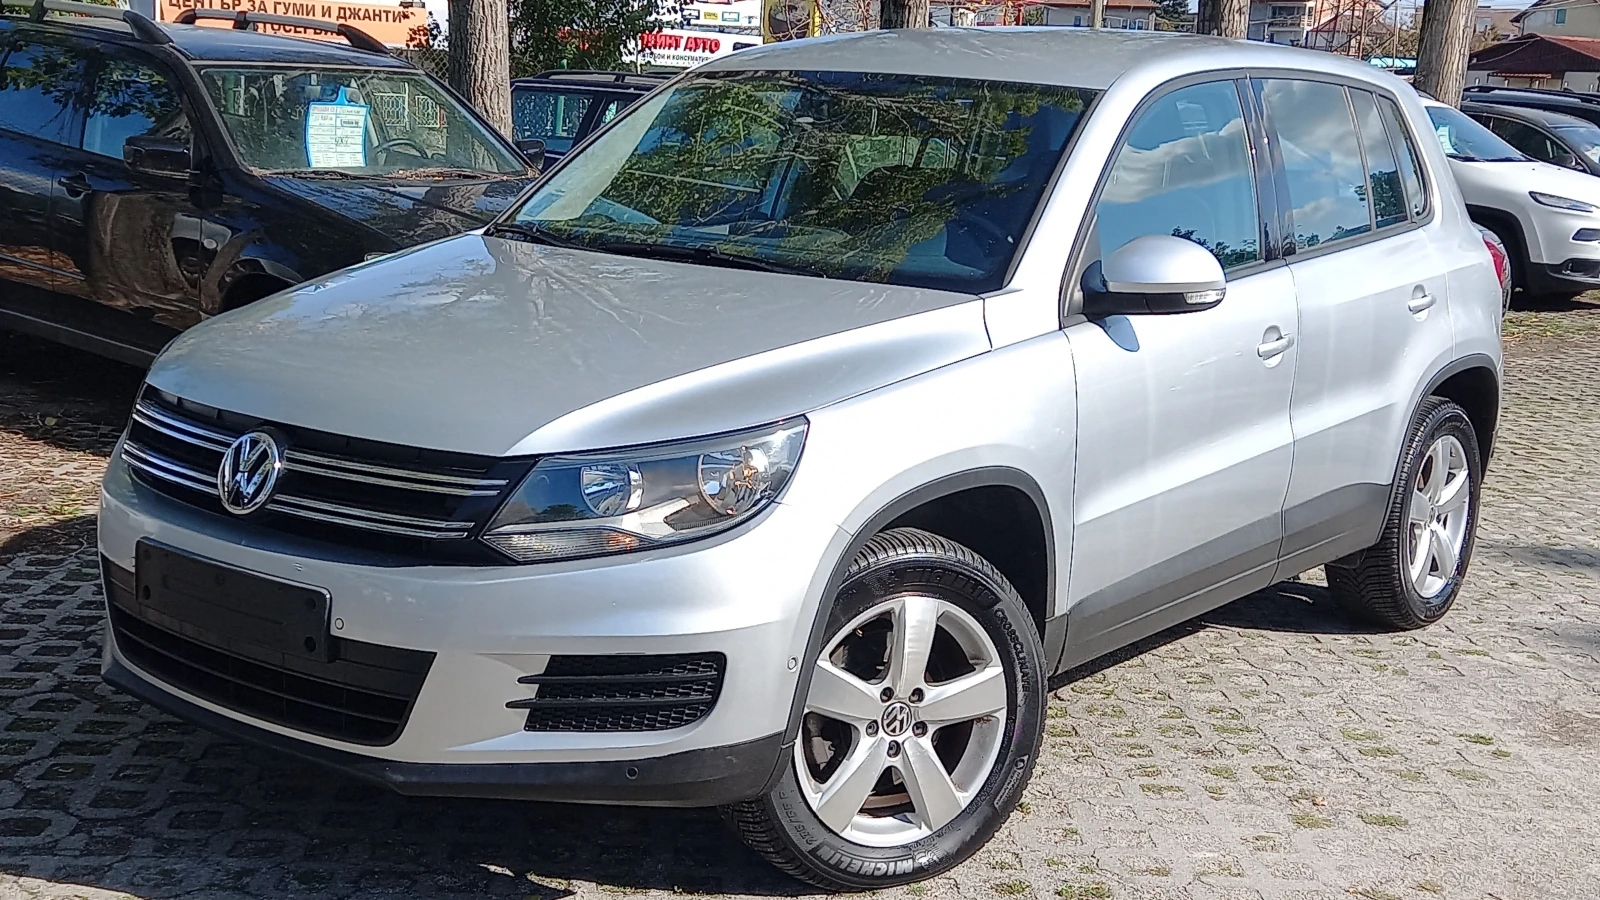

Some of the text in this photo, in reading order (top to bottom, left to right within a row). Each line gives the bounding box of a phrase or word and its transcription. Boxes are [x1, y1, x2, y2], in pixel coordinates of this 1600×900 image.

[247, 0, 270, 13] ЗА
[273, 1, 316, 17] ГУМИ
[321, 5, 332, 18] И
[336, 7, 402, 23] ДЖАНТИ
[684, 36, 720, 54] АУТО
[816, 844, 913, 876] MICHELIN
